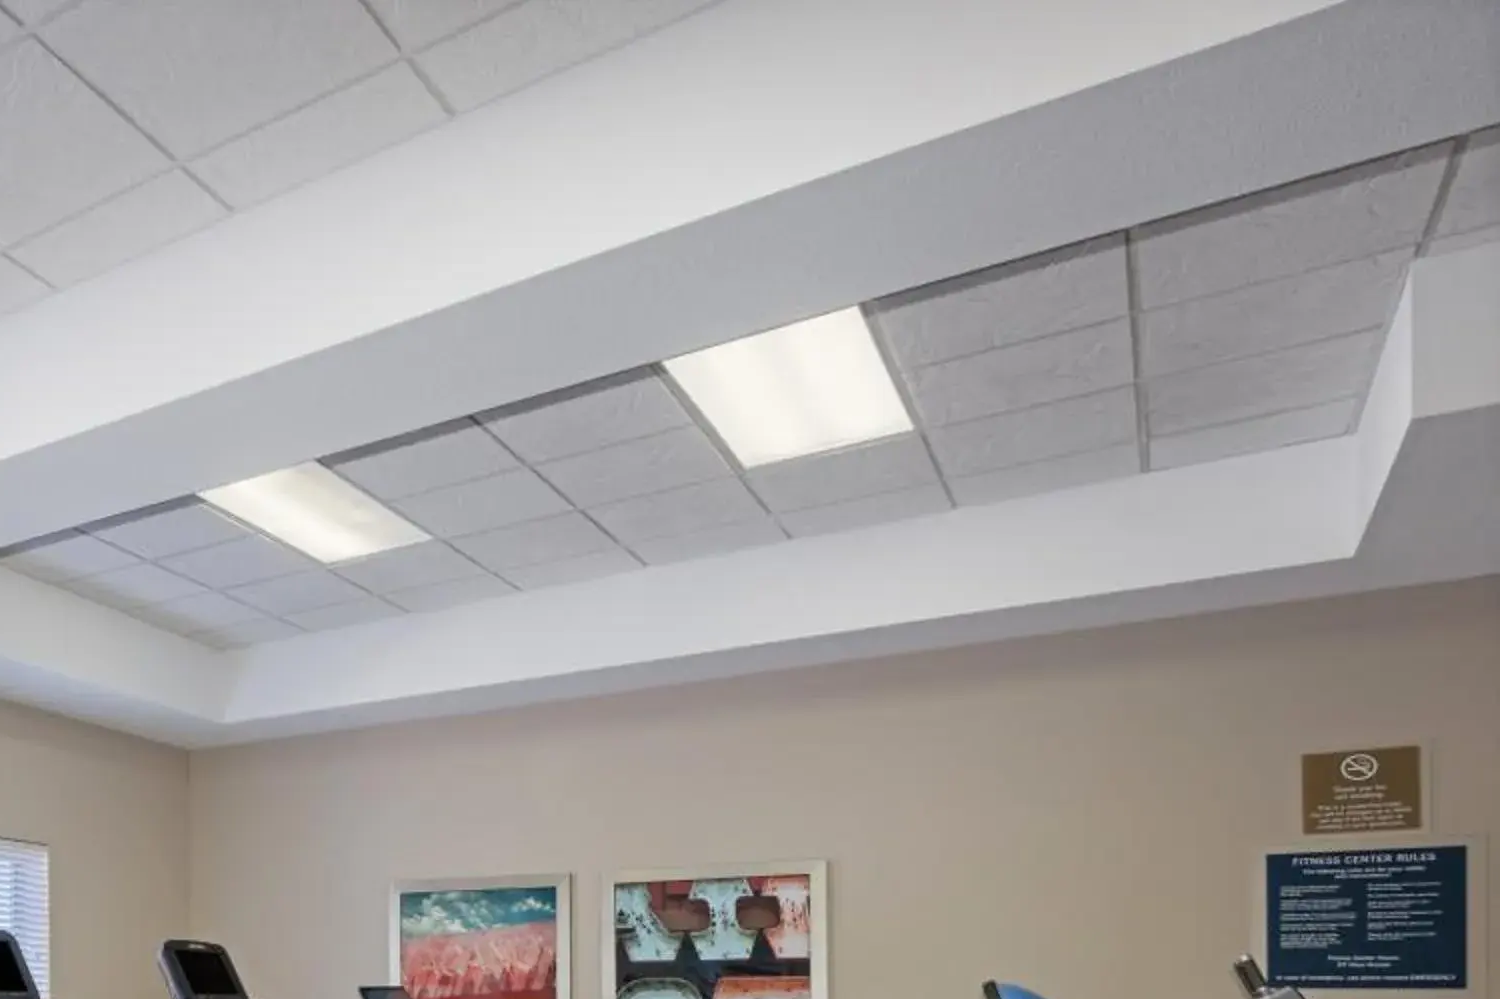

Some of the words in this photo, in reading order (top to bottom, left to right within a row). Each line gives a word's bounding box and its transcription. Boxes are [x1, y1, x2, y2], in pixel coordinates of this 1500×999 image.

[1291, 857, 1341, 866] FITNESS
[1343, 855, 1393, 865] CENTER
[1396, 852, 1437, 862] RULES
